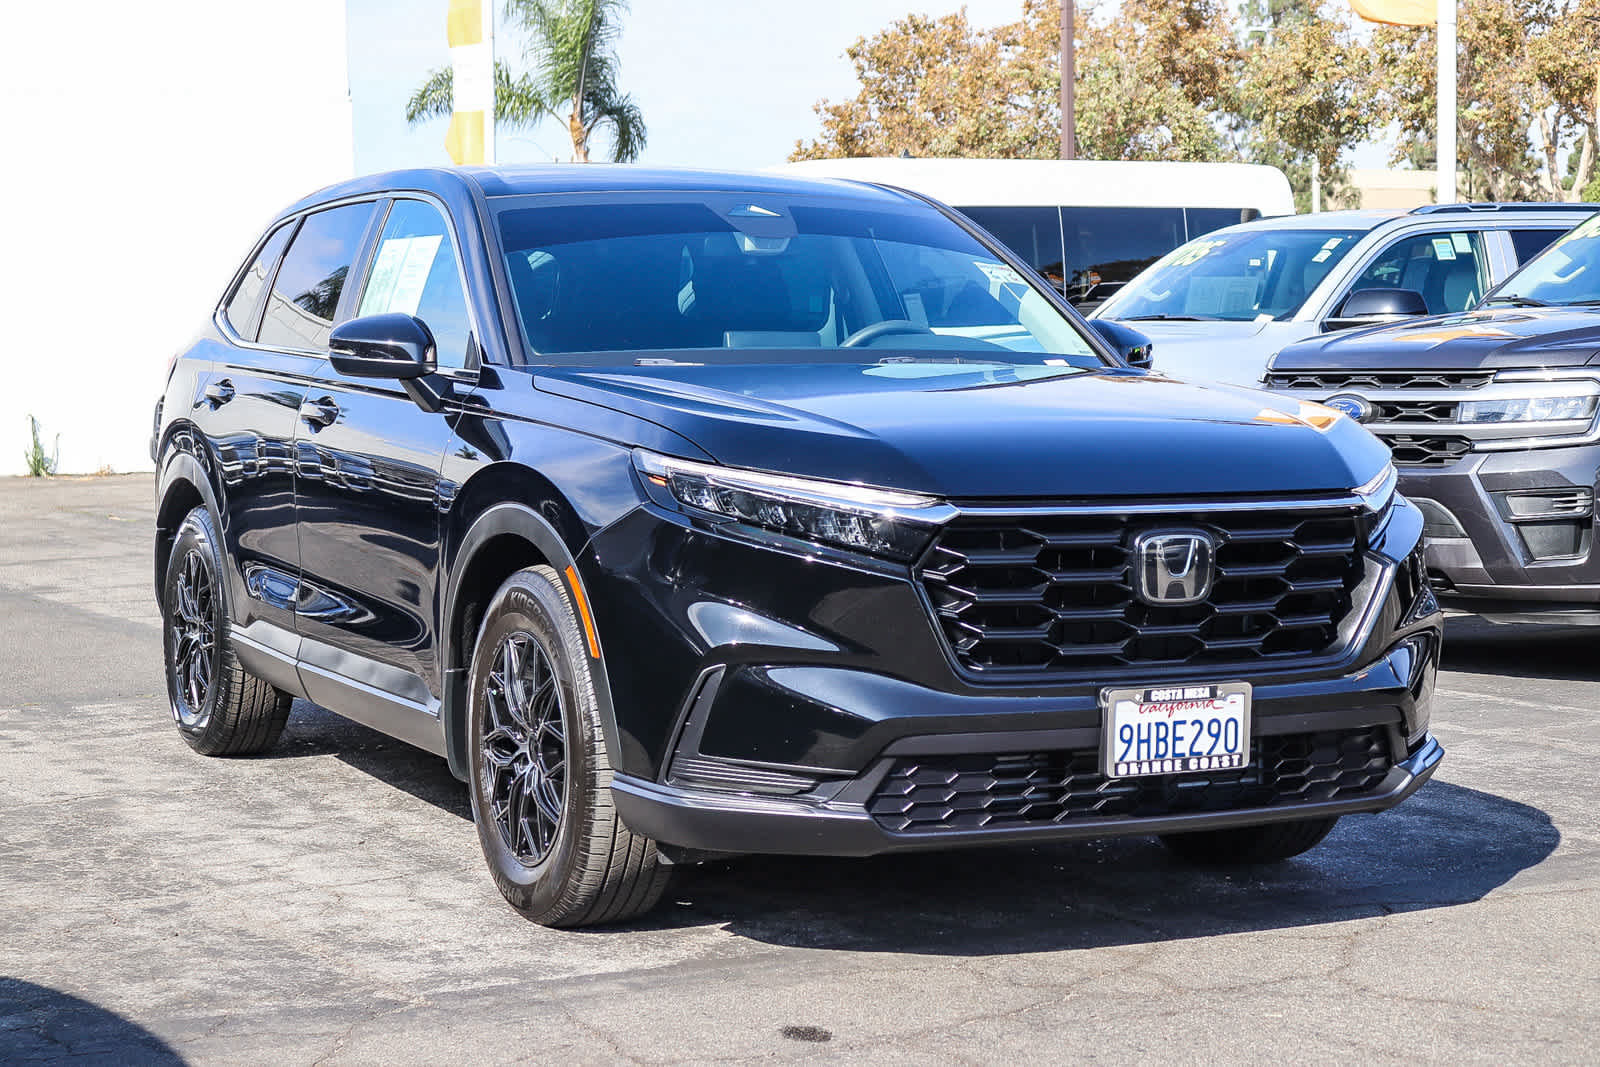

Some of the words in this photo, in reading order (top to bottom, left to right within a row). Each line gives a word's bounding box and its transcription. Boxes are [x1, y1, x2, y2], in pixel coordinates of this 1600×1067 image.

[1151, 689, 1183, 702] COSTA
[1139, 700, 1224, 718] California
[1119, 717, 1239, 762] 9HBE290
[1116, 758, 1183, 776] ORANGE
[1188, 754, 1241, 770] COAST
